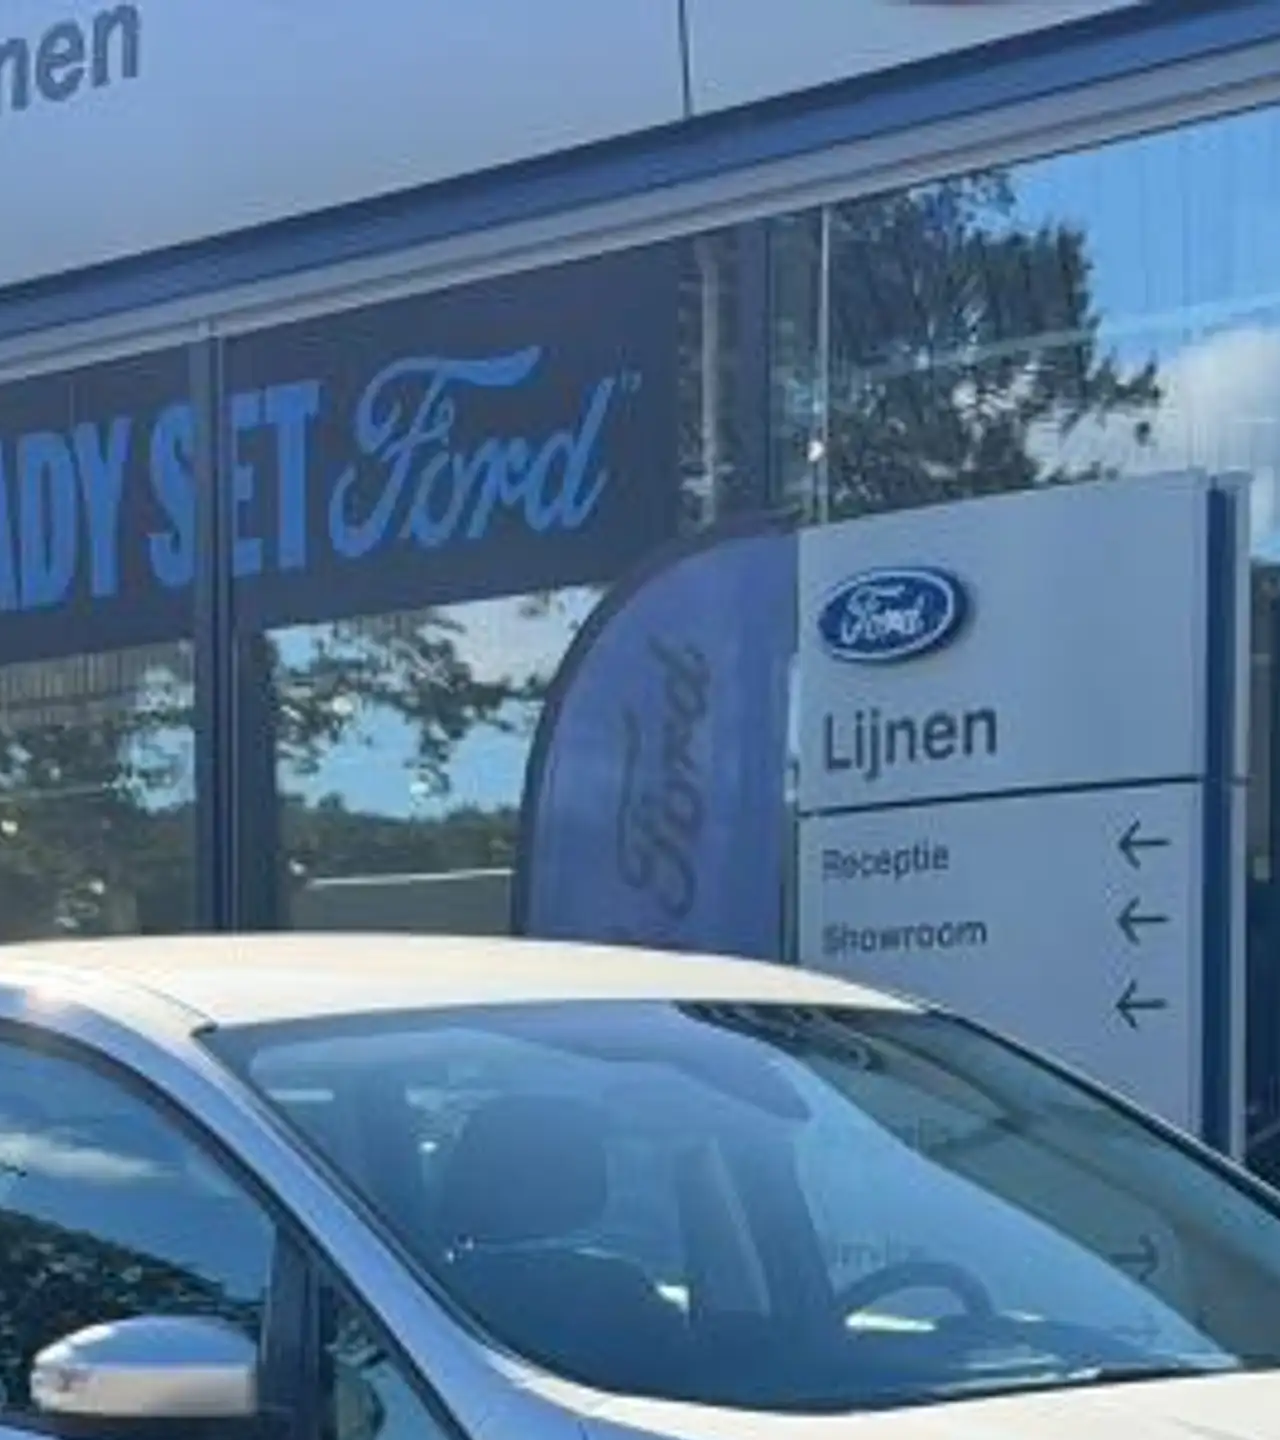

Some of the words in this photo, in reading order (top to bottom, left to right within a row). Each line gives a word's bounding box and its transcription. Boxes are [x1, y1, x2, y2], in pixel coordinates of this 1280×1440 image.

[148, 379, 321, 589] SET
[328, 345, 609, 560] Ford
[840, 584, 926, 643] Ford
[824, 706, 997, 780] Lijnen
[822, 840, 951, 880] Receptie
[822, 919, 988, 955] Showroom
